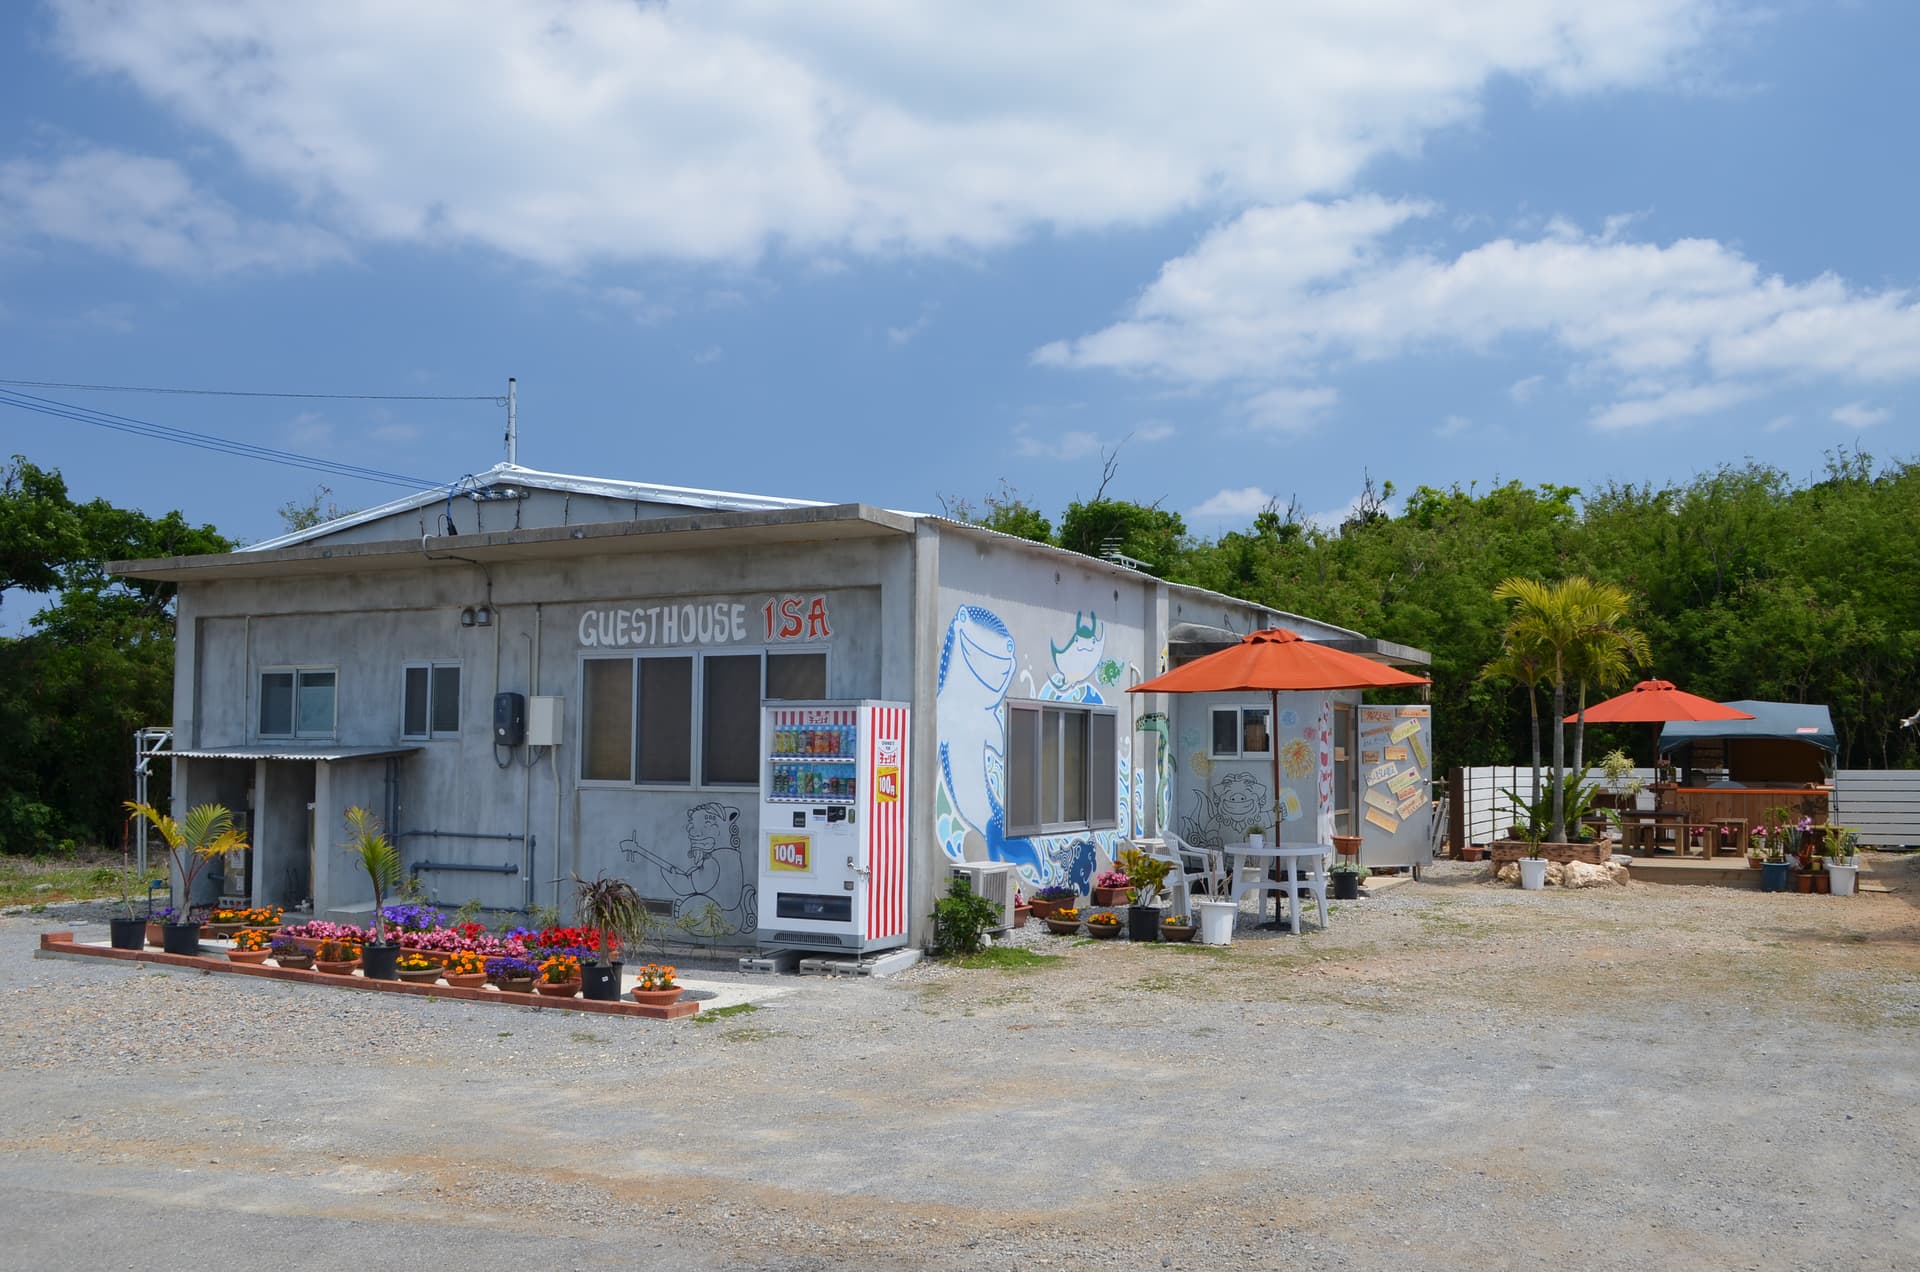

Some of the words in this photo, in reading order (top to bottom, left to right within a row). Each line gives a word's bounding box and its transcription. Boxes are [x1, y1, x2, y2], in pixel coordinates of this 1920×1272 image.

[578, 603, 747, 647] GUESTHOUSE
[763, 595, 833, 643] ISA
[879, 775, 896, 796] 100円
[774, 844, 803, 865] 100円
